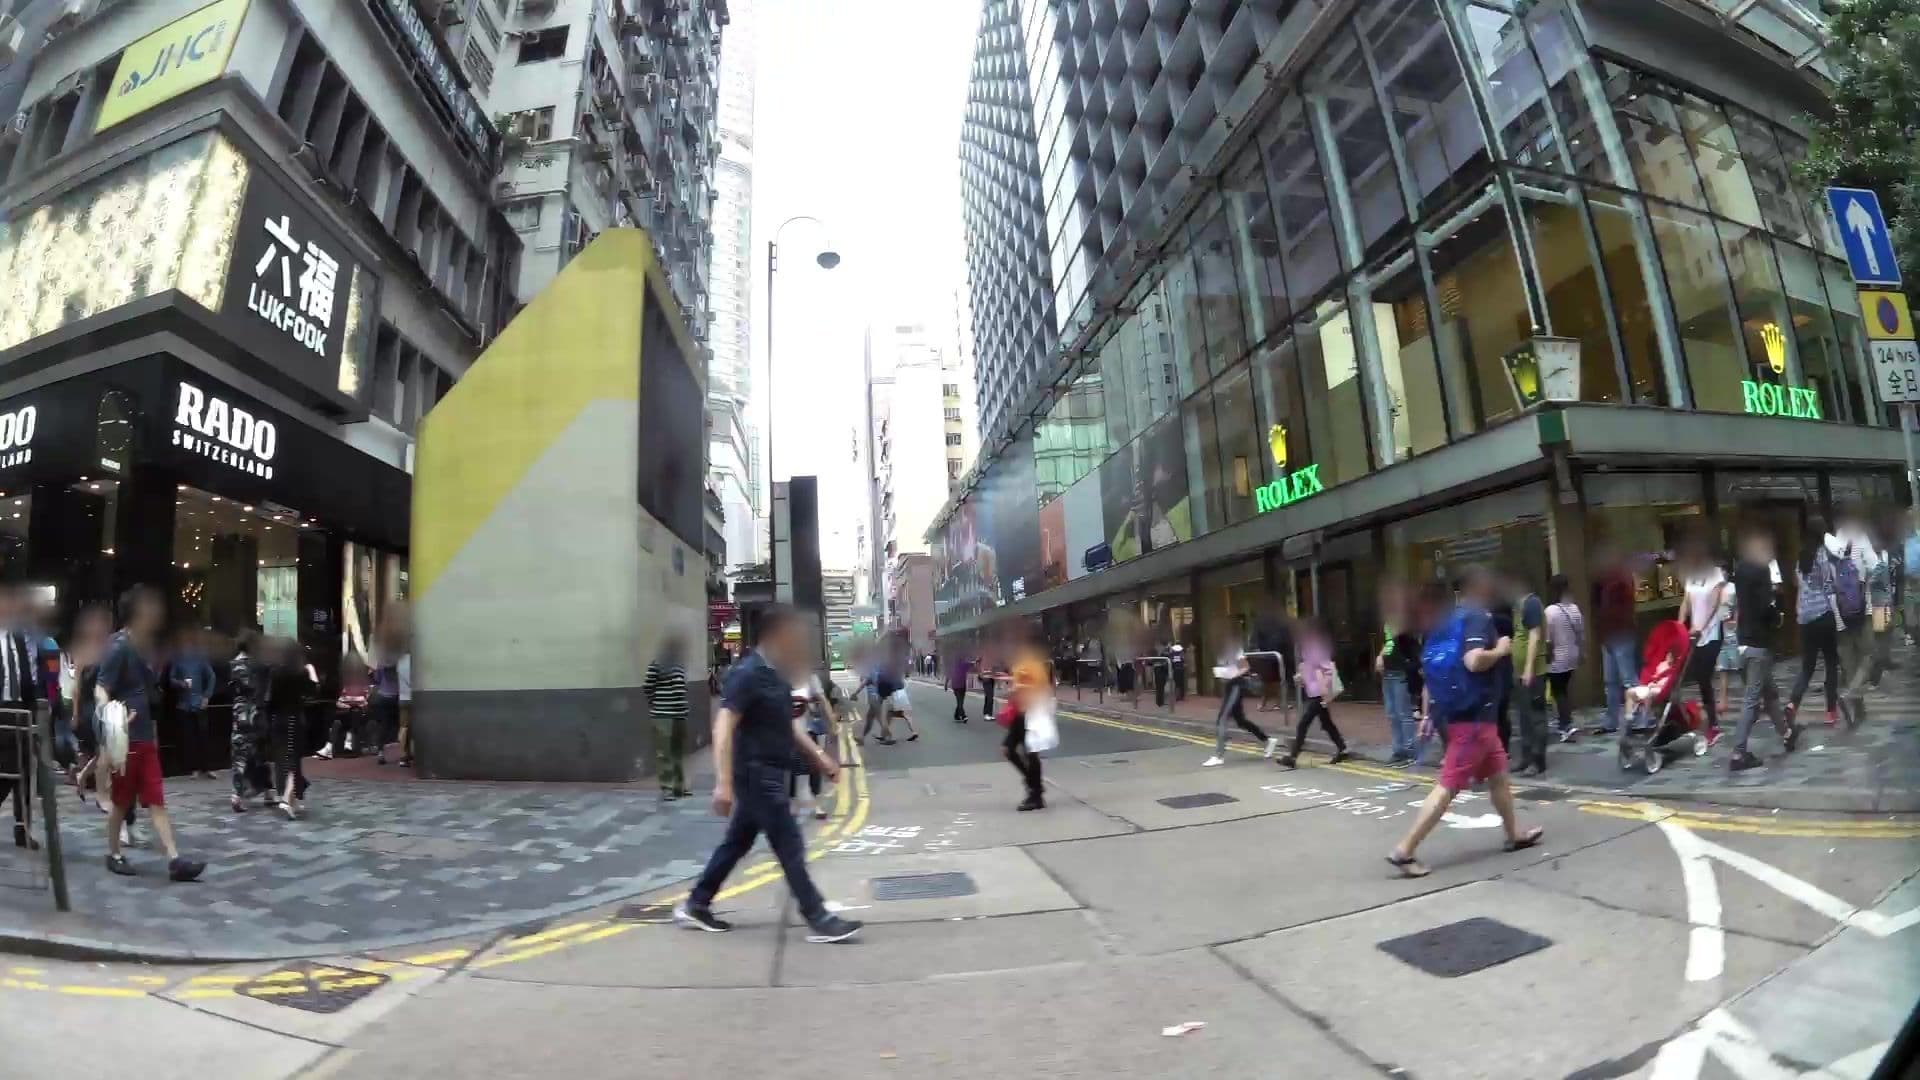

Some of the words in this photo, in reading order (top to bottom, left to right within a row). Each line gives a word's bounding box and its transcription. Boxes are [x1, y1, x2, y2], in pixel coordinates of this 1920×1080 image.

[255, 215, 338, 328] 六福
[175, 381, 276, 461] RADO
[1740, 380, 1821, 420] ROLEX
[172, 429, 273, 480] SWITZERLAND
[1255, 463, 1324, 513] ROLEX
